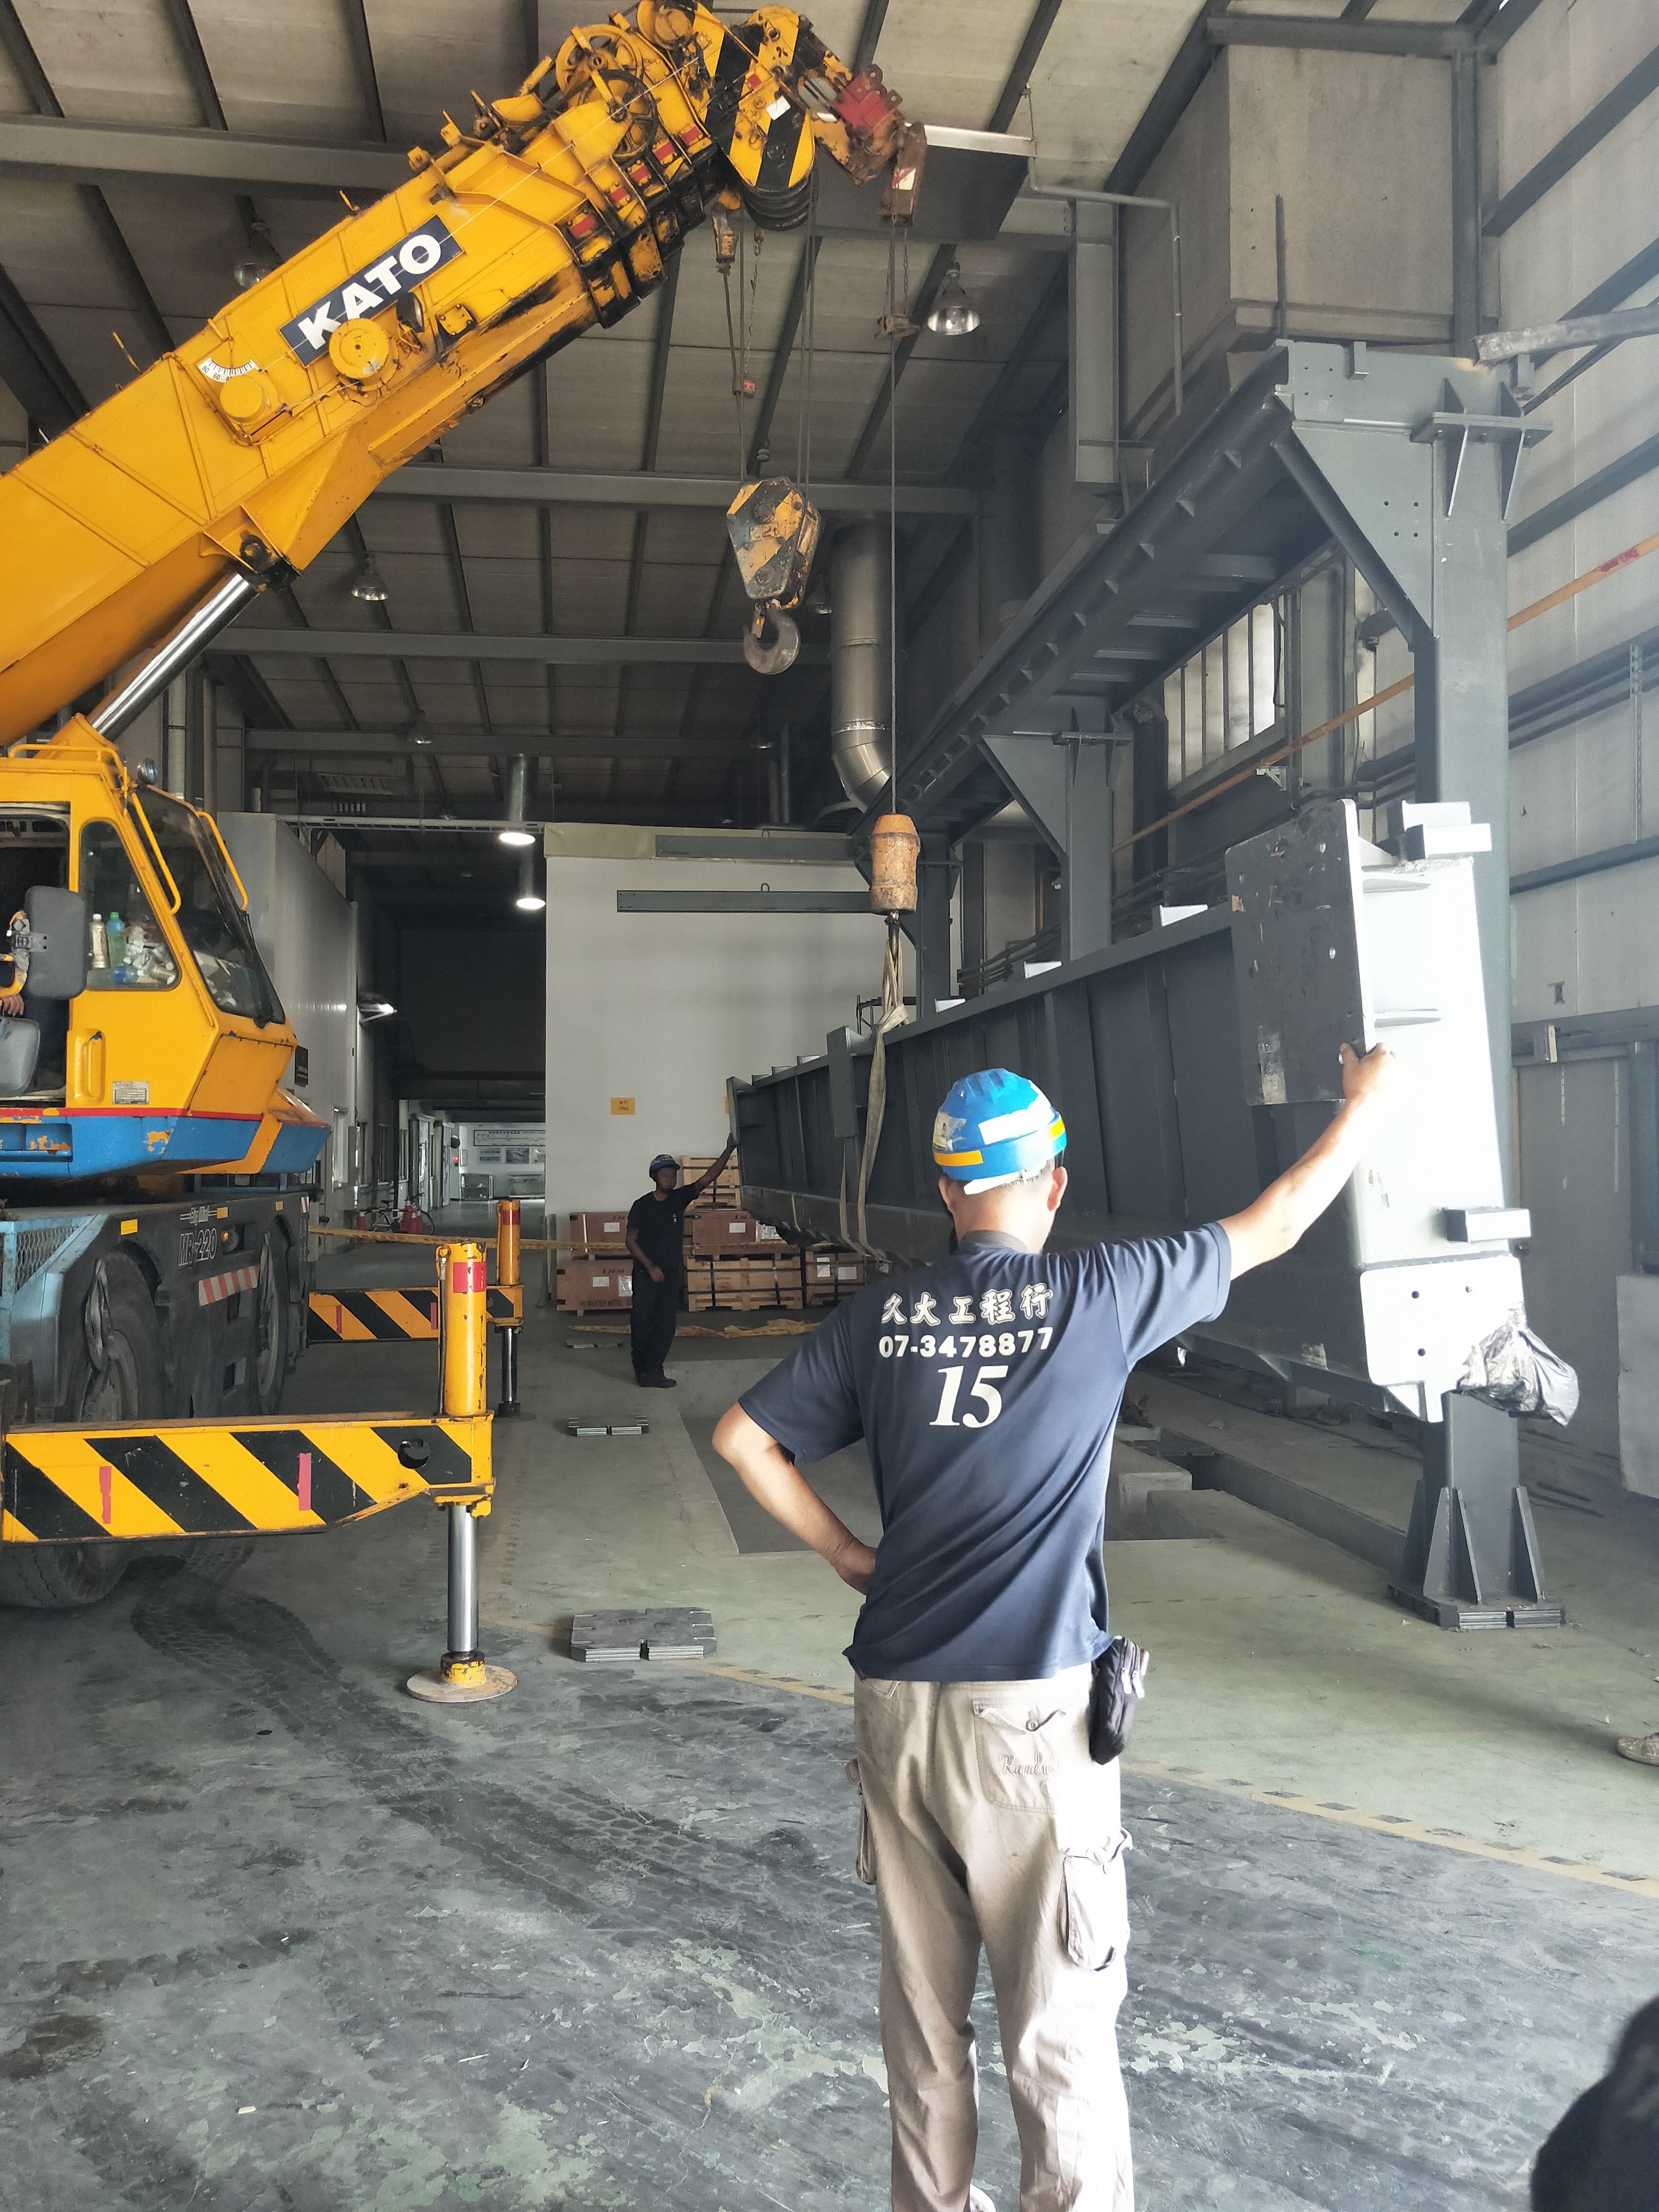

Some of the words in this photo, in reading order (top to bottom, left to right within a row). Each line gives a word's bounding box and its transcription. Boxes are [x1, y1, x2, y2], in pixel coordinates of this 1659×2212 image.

[298, 234, 441, 350] KATO
[880, 1283, 1054, 1326] 久大工程行
[879, 1326, 1054, 1358] 07-3478877
[929, 1365, 1009, 1429] 15
